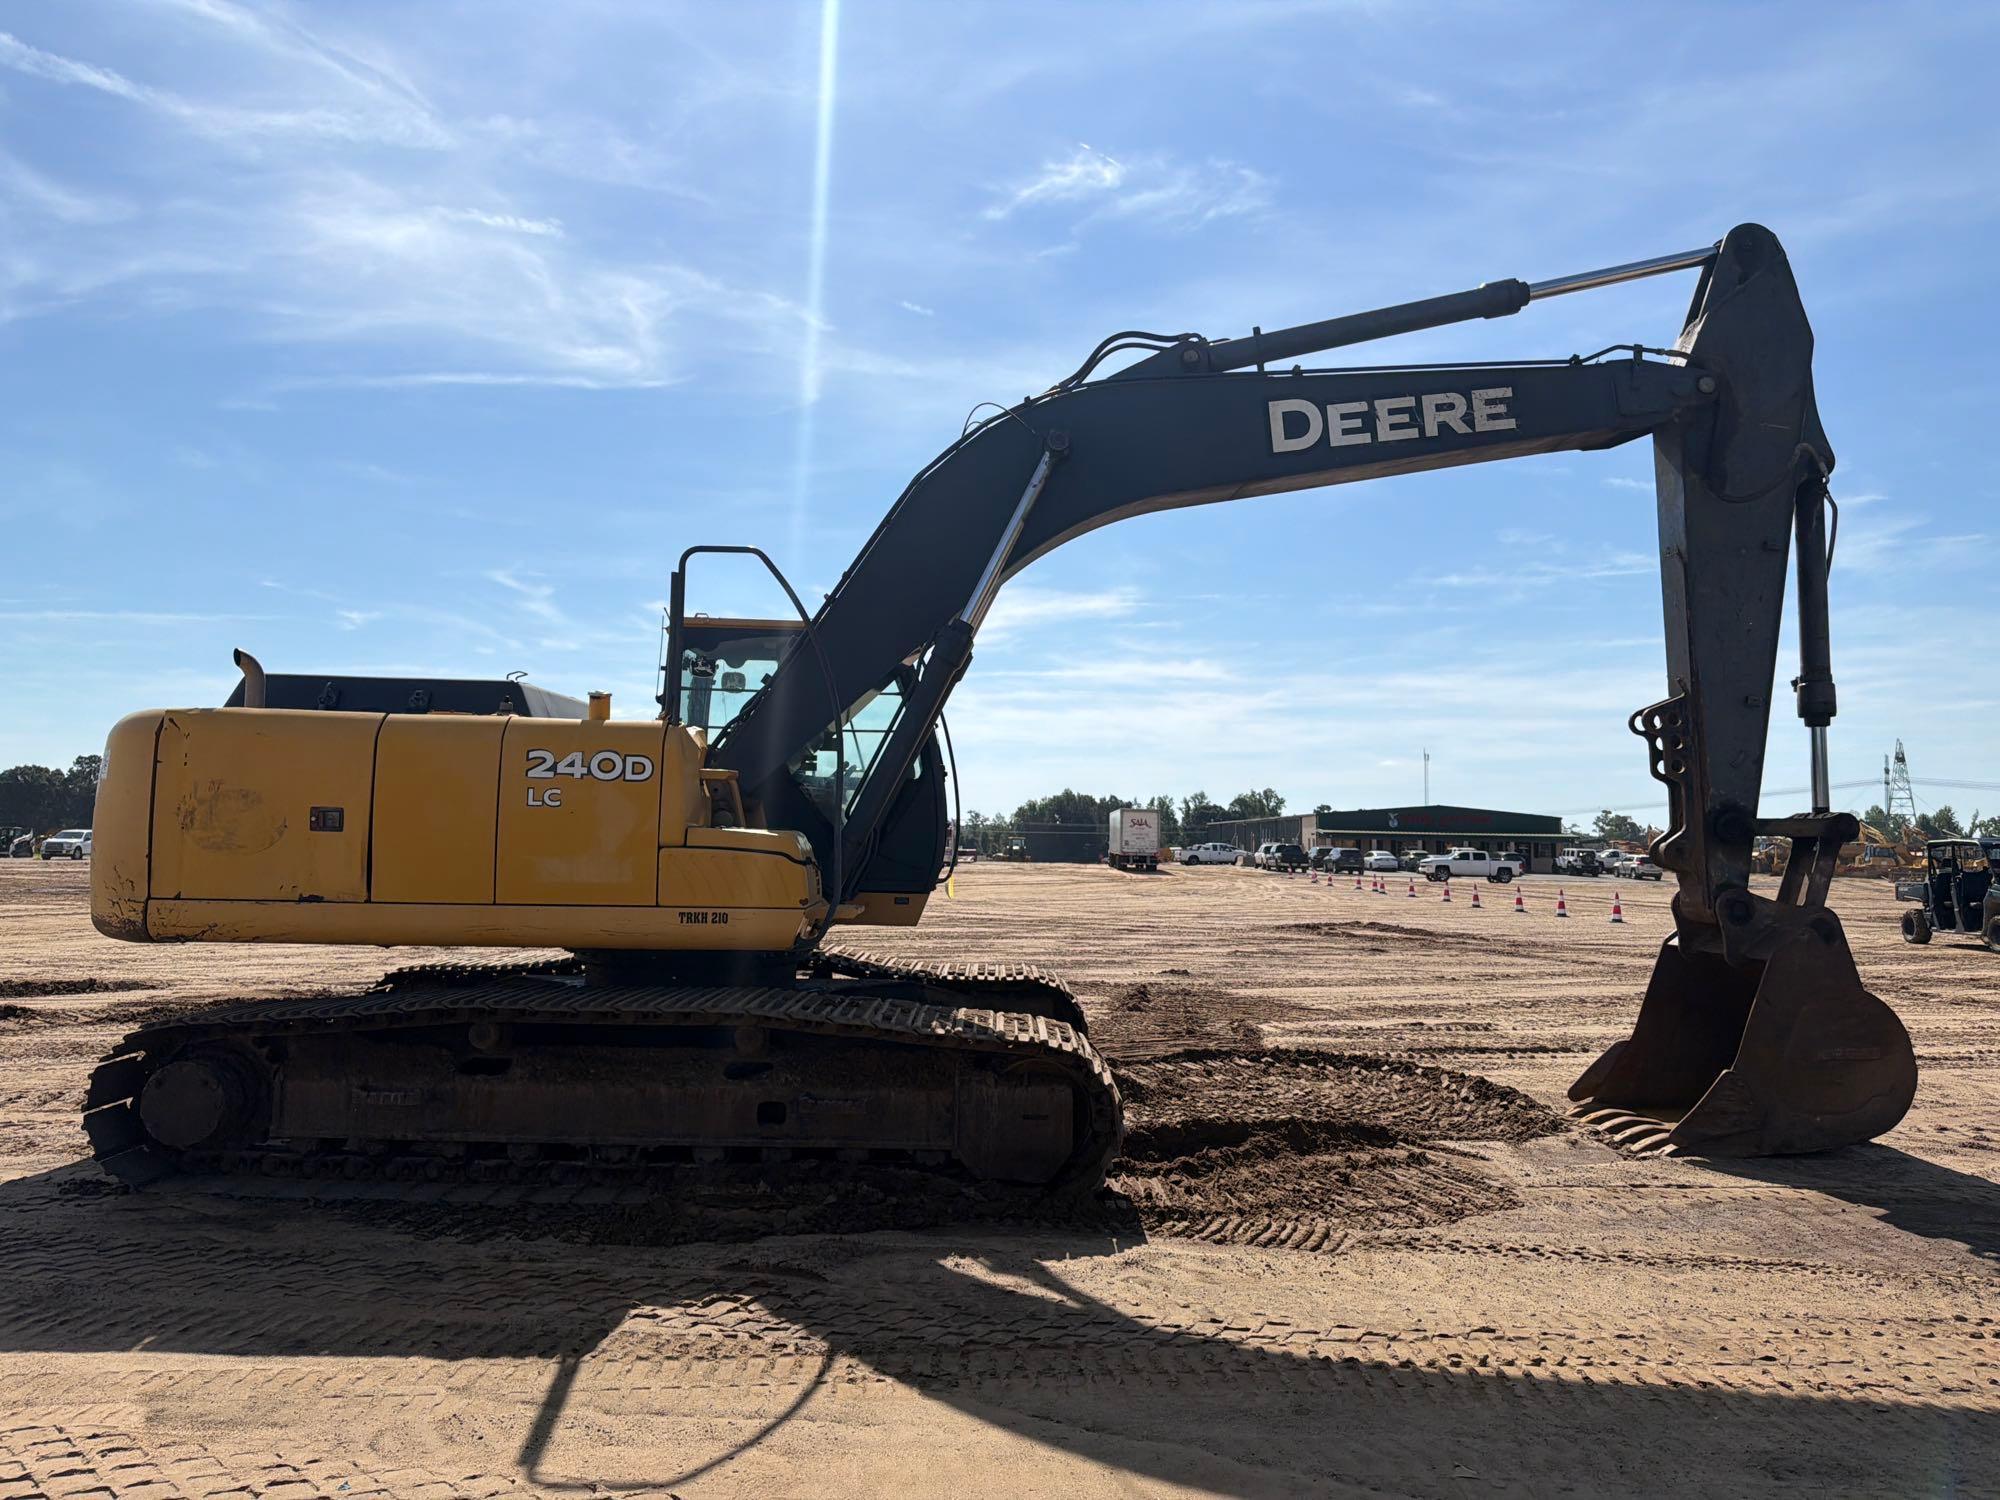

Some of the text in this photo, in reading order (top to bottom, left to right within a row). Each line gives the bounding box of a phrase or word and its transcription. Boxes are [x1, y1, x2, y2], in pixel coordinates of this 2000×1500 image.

[1268, 386, 1517, 453] DEERE
[526, 749, 655, 782] 240D
[526, 787, 562, 807] LC
[678, 911, 709, 925] TRKH
[710, 911, 729, 925] 210
